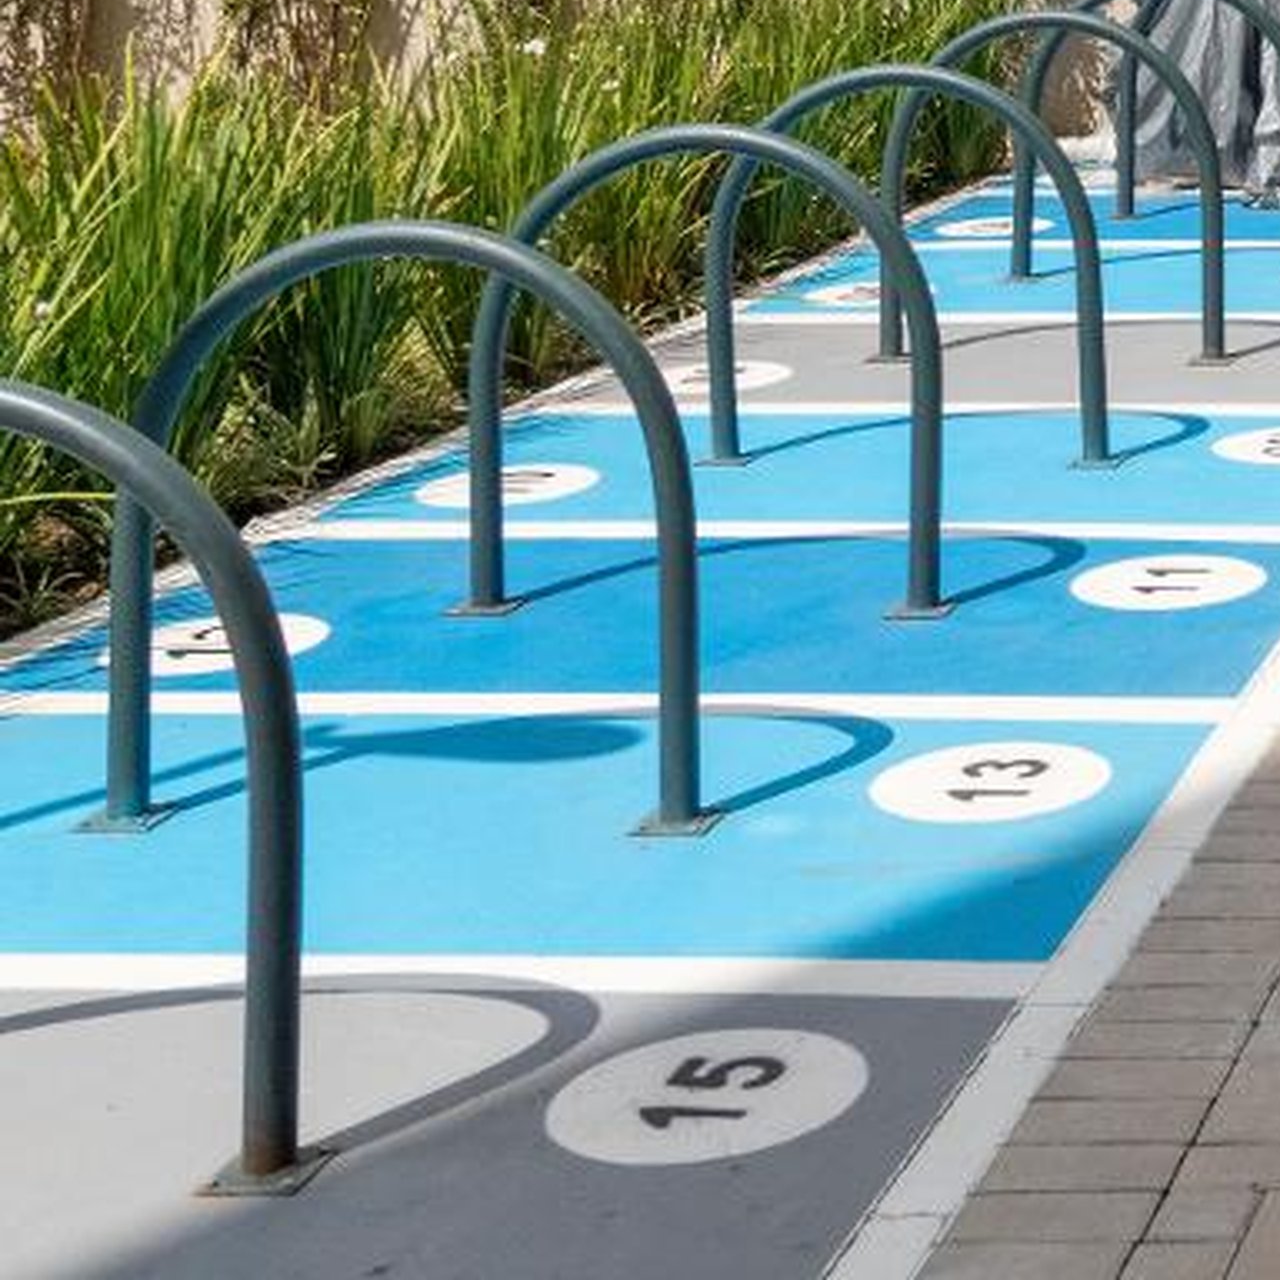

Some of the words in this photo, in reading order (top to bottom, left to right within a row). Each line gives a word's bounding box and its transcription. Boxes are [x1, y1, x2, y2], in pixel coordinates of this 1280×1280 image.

[1131, 568, 1211, 595] 11
[946, 758, 1051, 802] 13
[638, 1055, 788, 1130] 15
